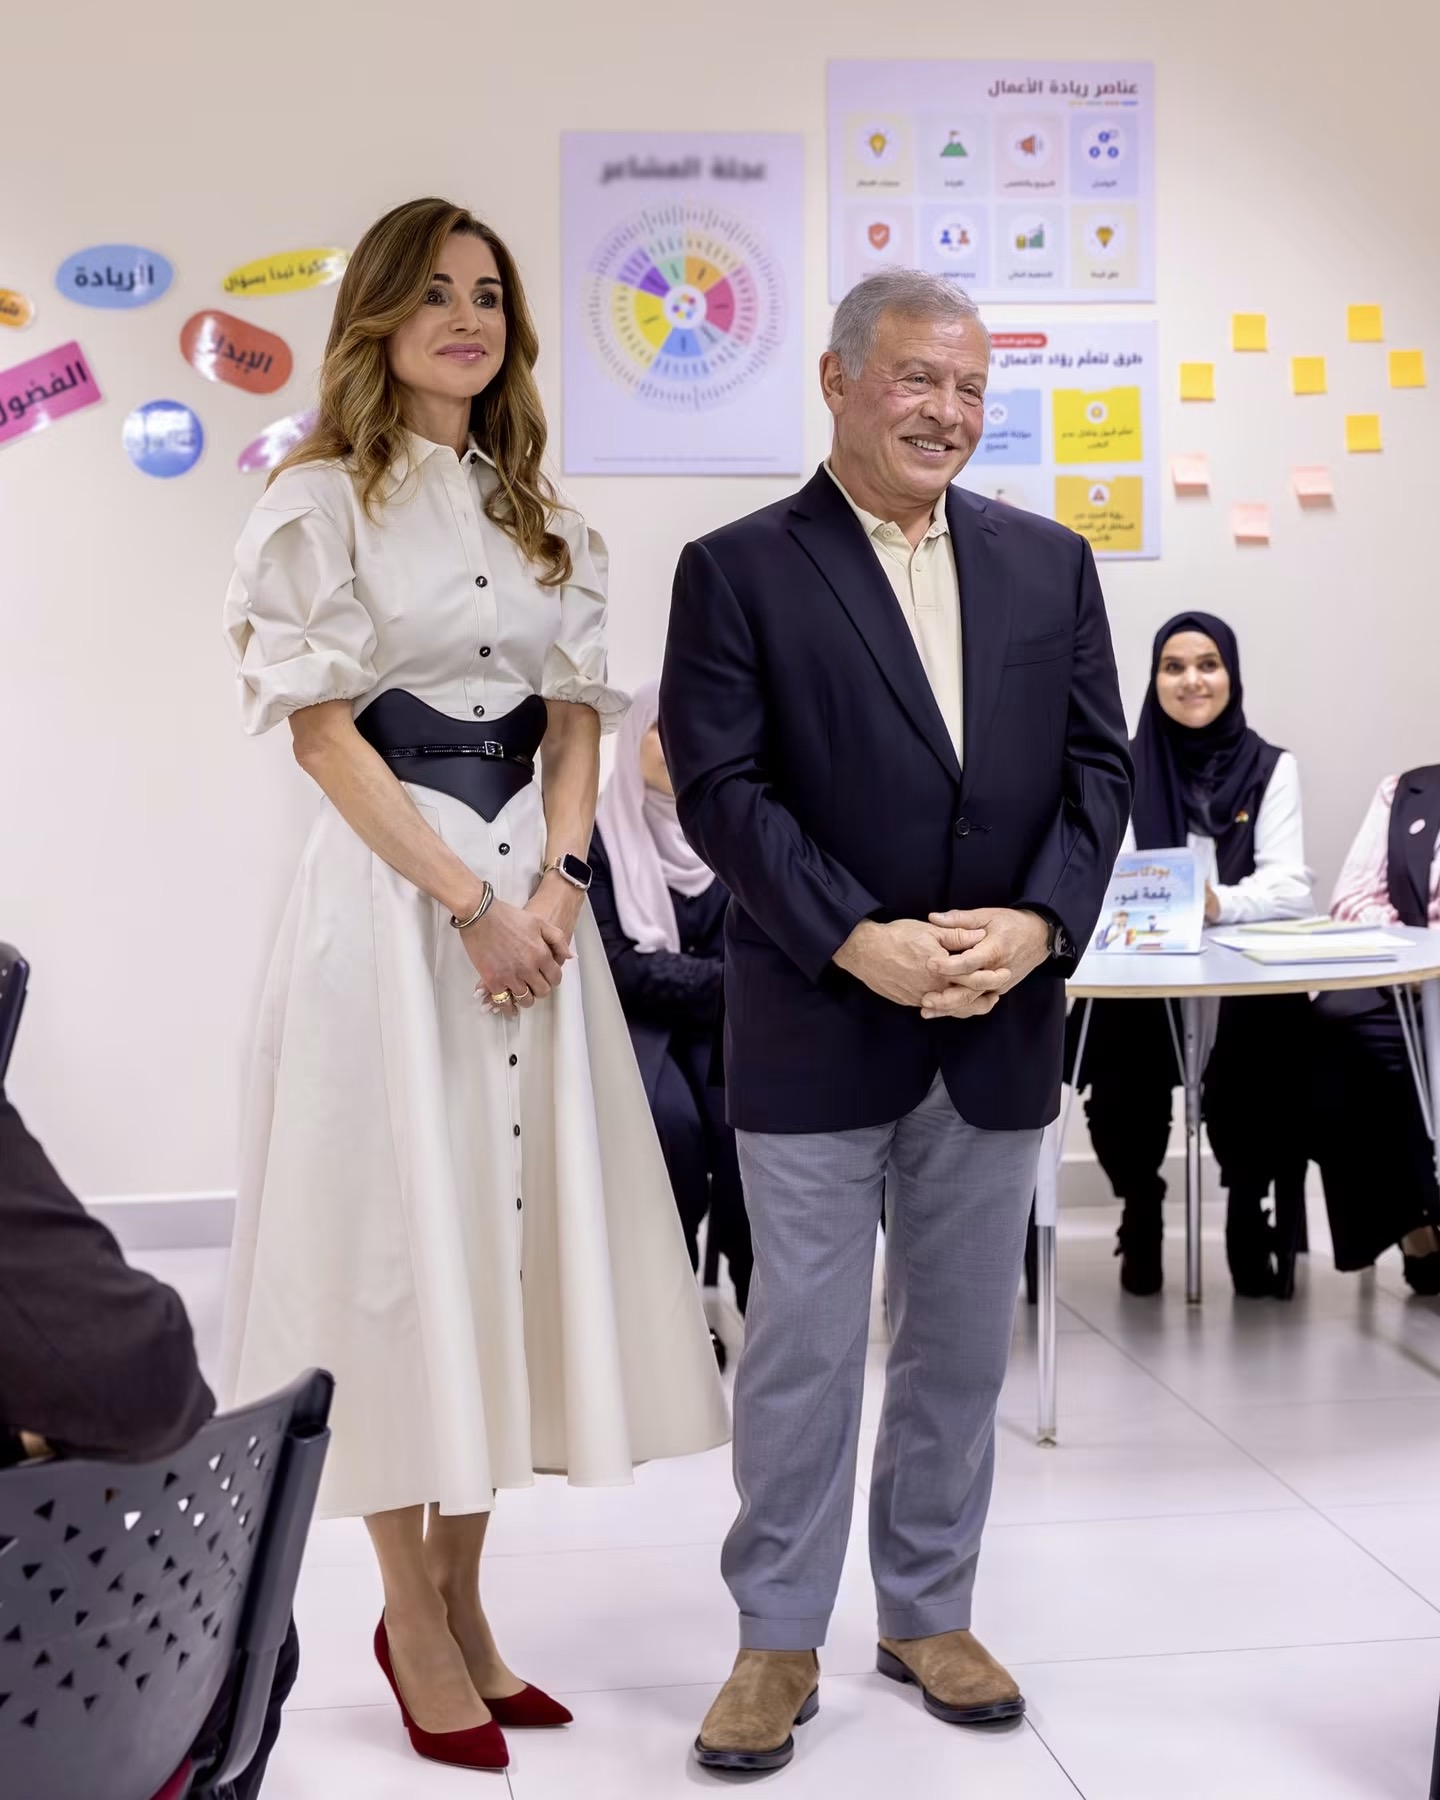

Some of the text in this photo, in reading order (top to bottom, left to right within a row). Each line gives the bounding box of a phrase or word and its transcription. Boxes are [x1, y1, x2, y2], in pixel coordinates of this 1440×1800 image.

[988, 78, 1138, 97] عناصر ريادة الأعمال
[74, 264, 154, 292] الريادة
[206, 334, 274, 375] الإبدا
[1142, 886, 1171, 902] بقعة
